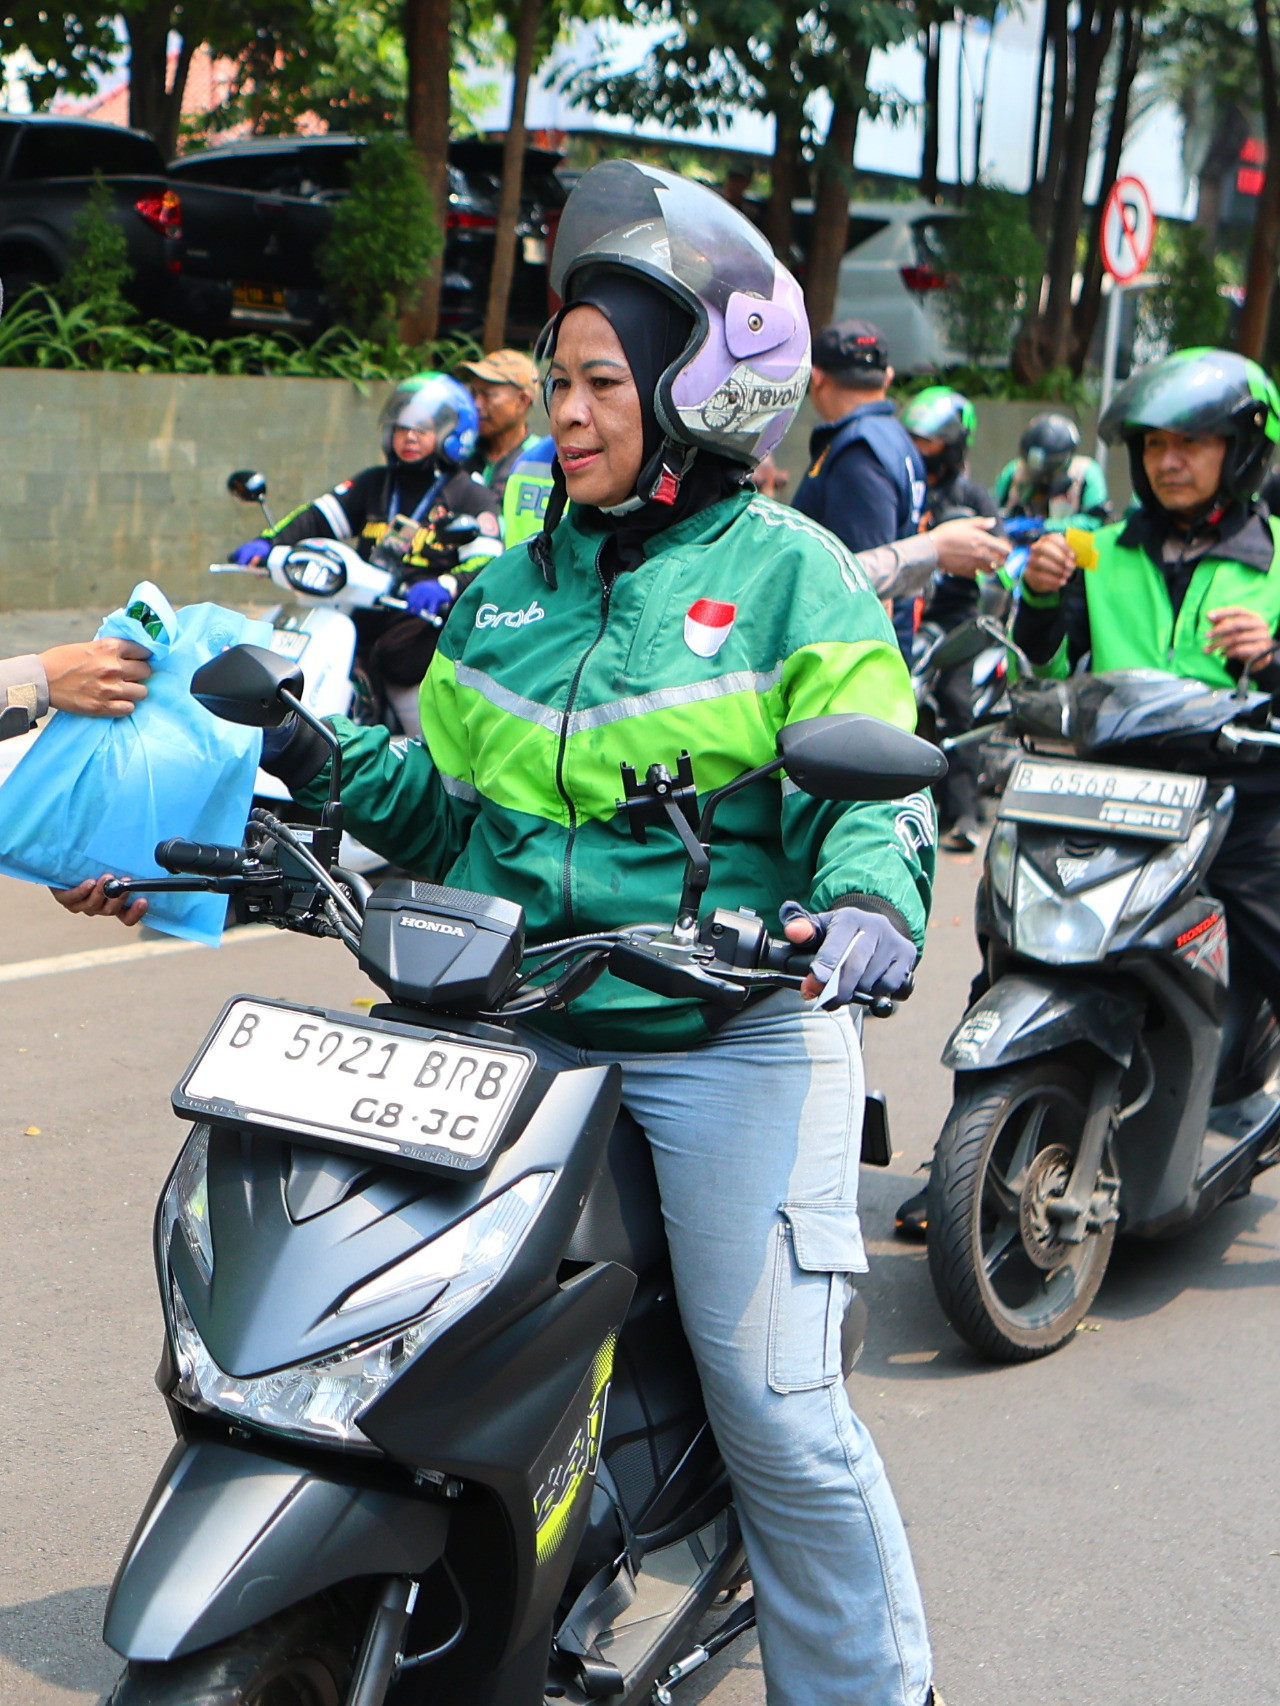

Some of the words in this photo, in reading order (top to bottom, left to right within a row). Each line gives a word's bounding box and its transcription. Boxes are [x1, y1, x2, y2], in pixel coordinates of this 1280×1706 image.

[515, 483, 553, 519] PO
[475, 601, 545, 628] Grab
[1020, 767, 1033, 788] B
[1050, 770, 1117, 798] 6568
[400, 916, 465, 938] HONDA
[229, 1012, 261, 1049] B
[284, 1023, 400, 1081] 5921
[413, 1050, 508, 1101] BRB
